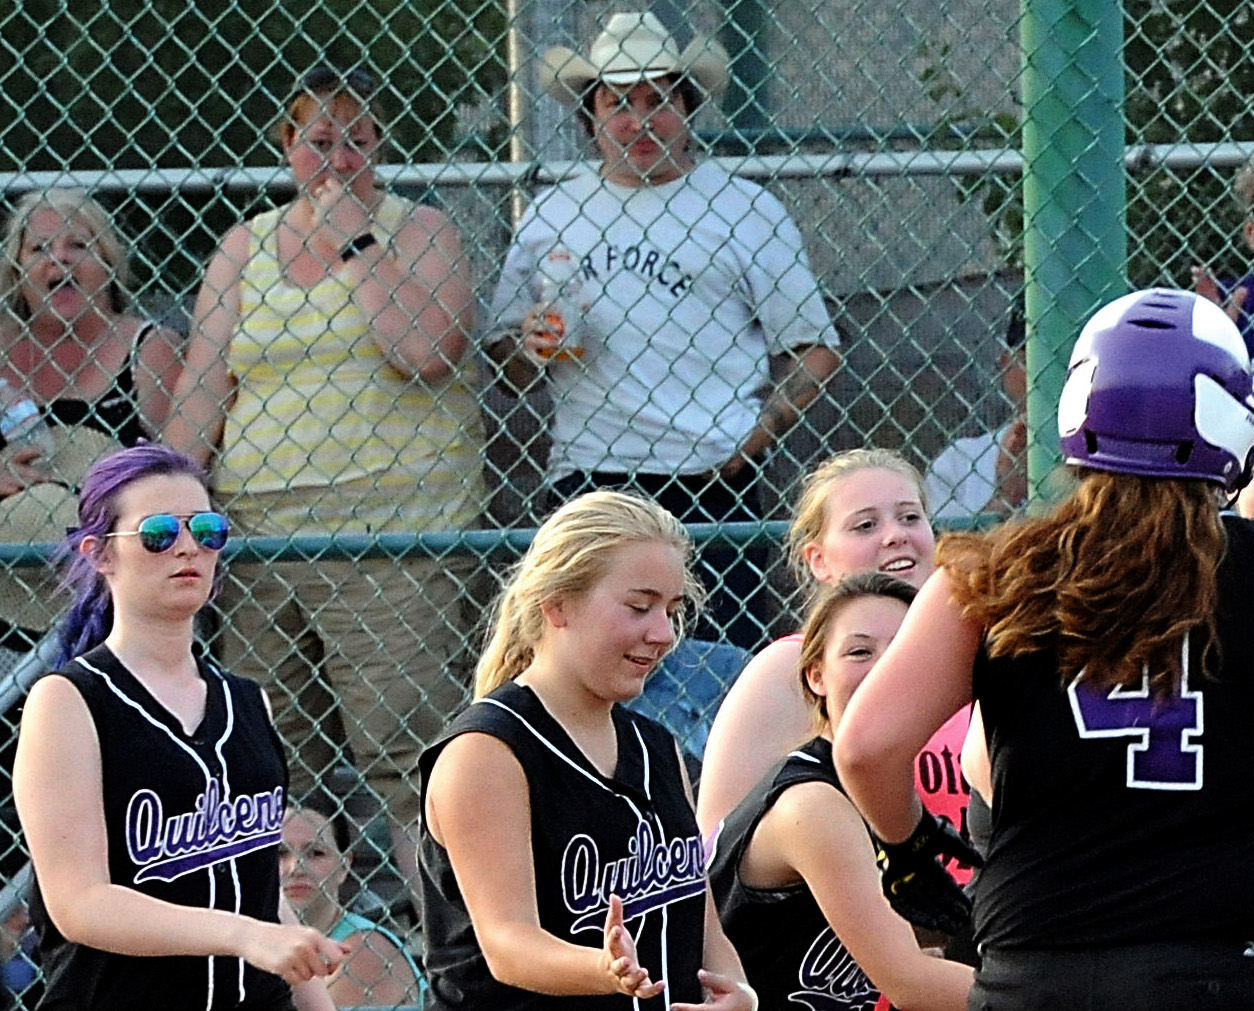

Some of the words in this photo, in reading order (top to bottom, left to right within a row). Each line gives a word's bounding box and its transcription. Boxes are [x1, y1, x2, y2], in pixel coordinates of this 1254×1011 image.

[606, 246, 692, 298] FORCE
[1067, 630, 1204, 791] 4
[561, 819, 706, 914] Quilcen
